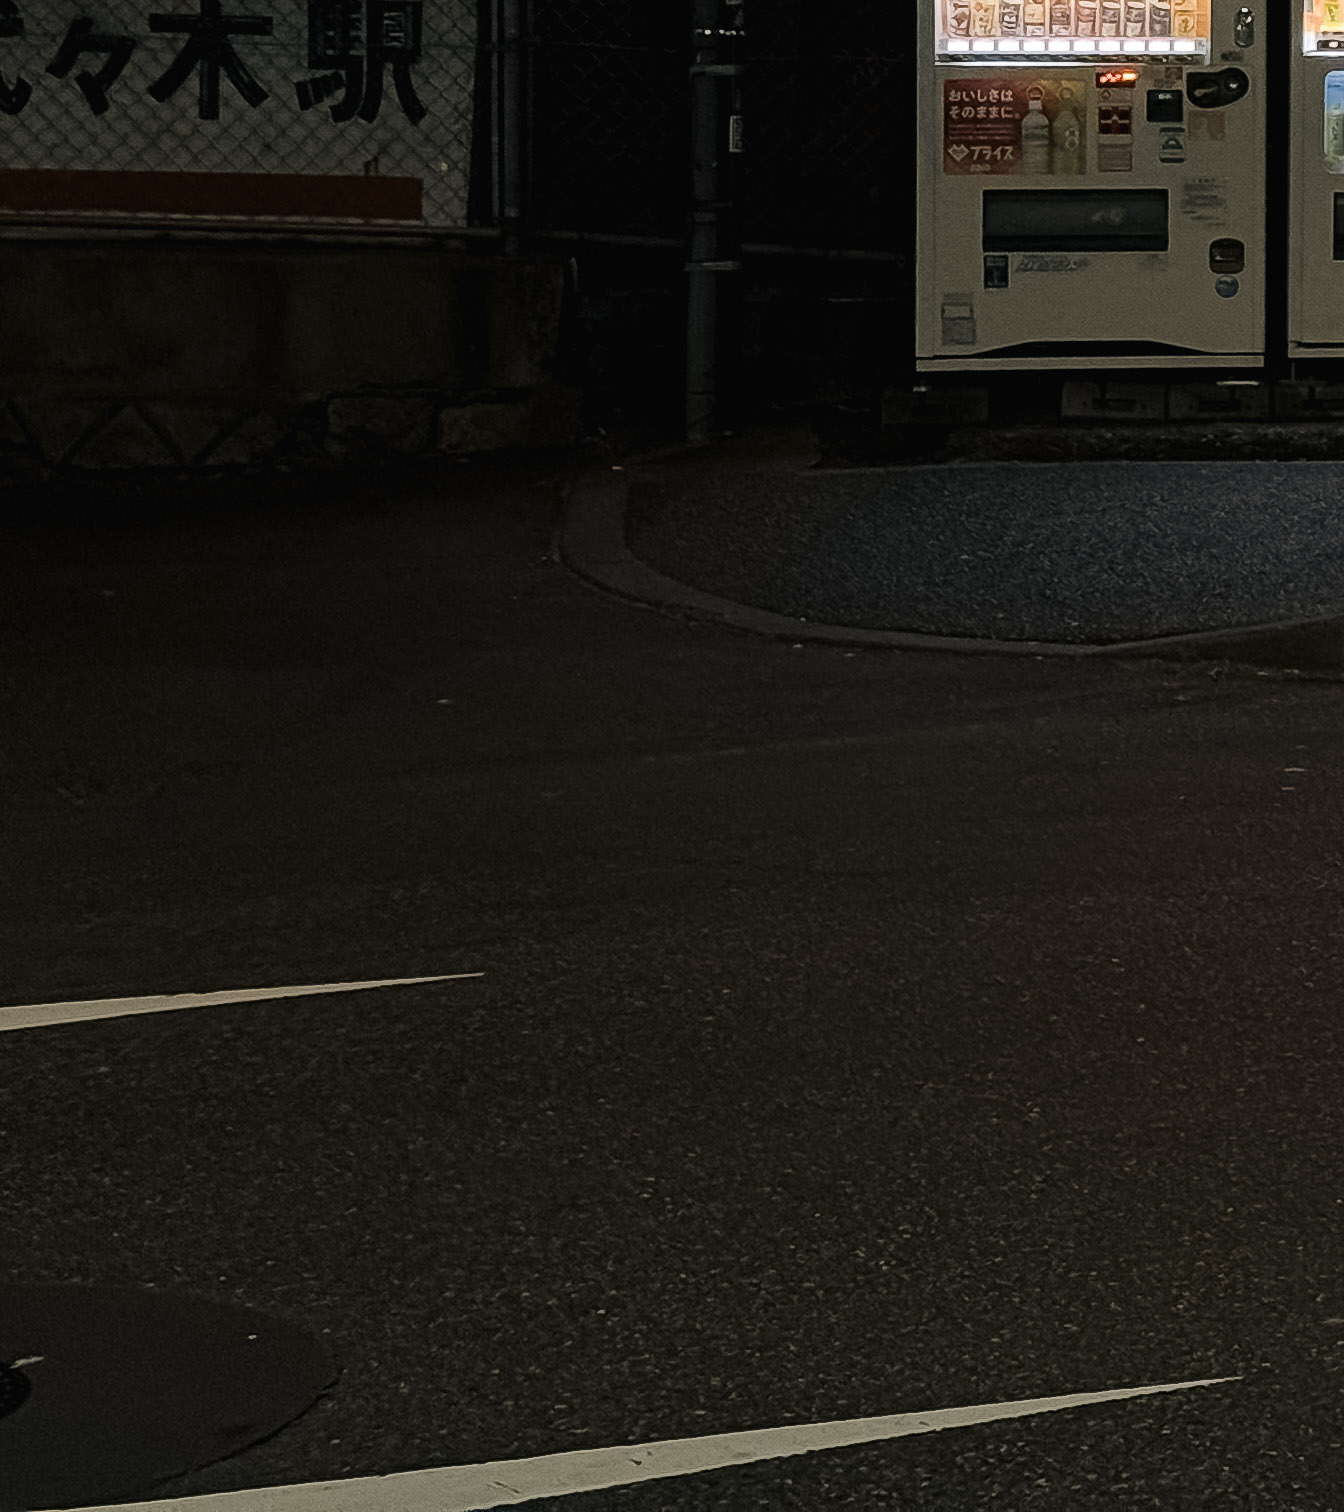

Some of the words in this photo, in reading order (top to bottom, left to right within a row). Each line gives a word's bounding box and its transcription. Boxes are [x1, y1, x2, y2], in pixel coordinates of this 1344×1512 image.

[948, 88, 1014, 103] おいしさは
